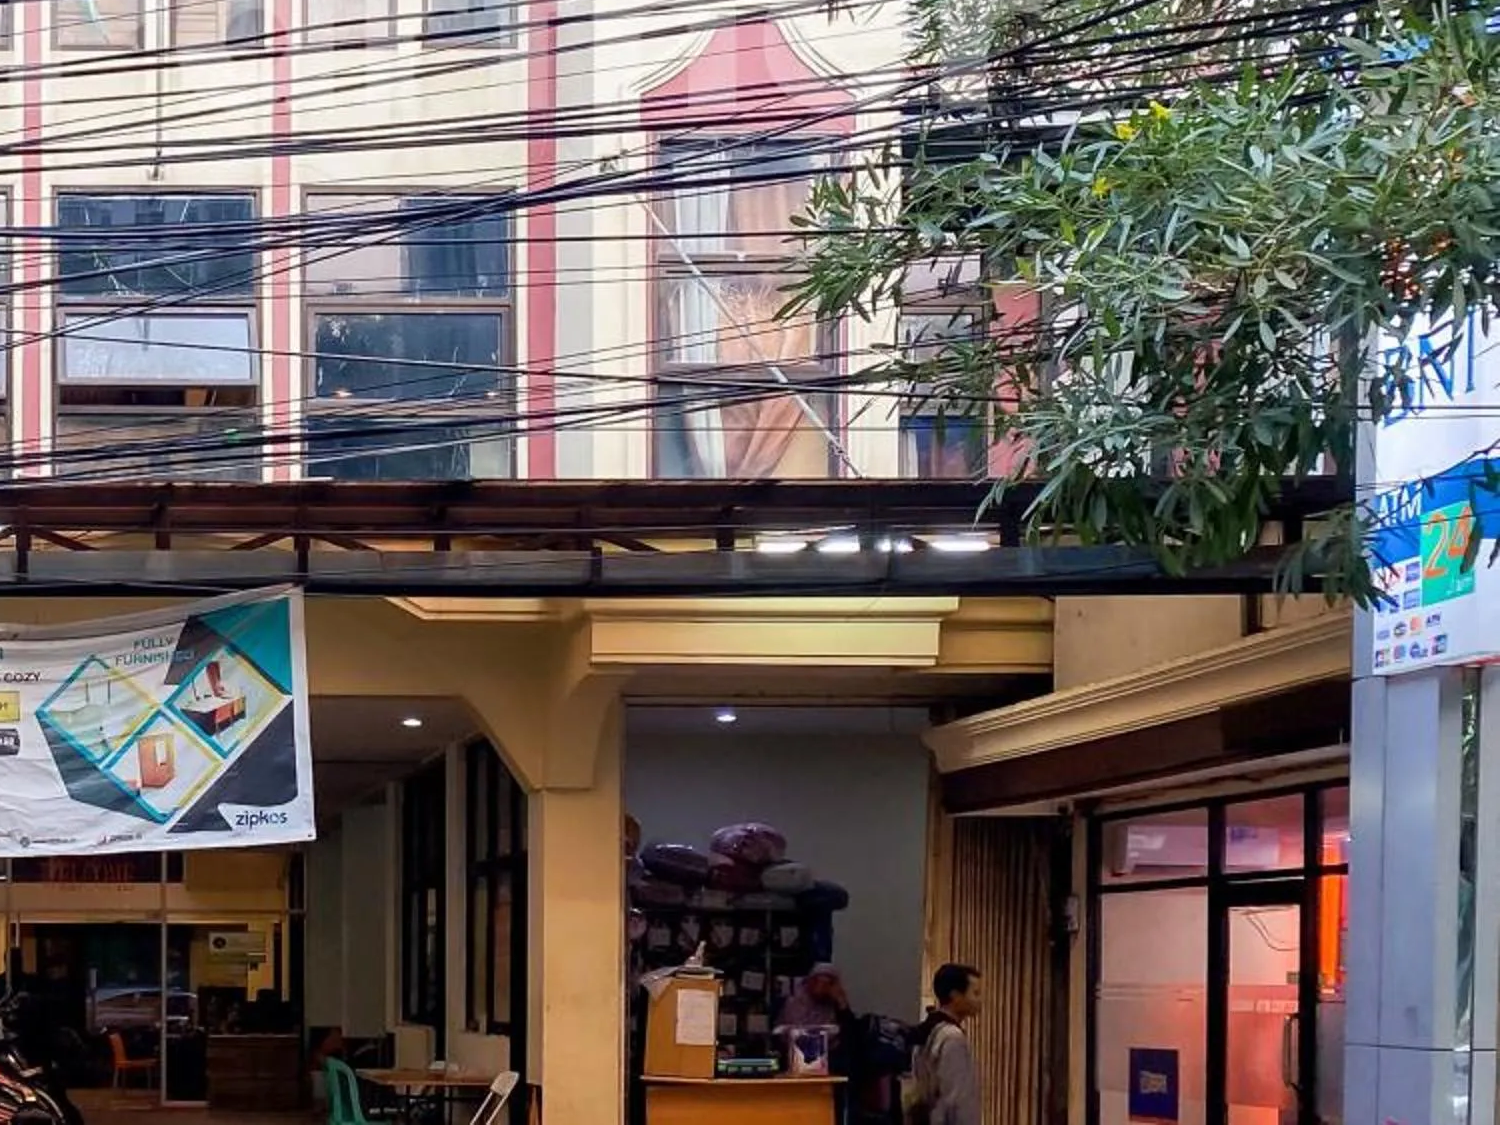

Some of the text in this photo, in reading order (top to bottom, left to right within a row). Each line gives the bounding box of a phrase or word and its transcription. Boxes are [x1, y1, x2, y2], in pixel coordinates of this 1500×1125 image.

[1378, 300, 1477, 428] BNI
[1378, 483, 1422, 531] ATM
[3, 671, 41, 683] COZY
[235, 809, 289, 827] zipkos
